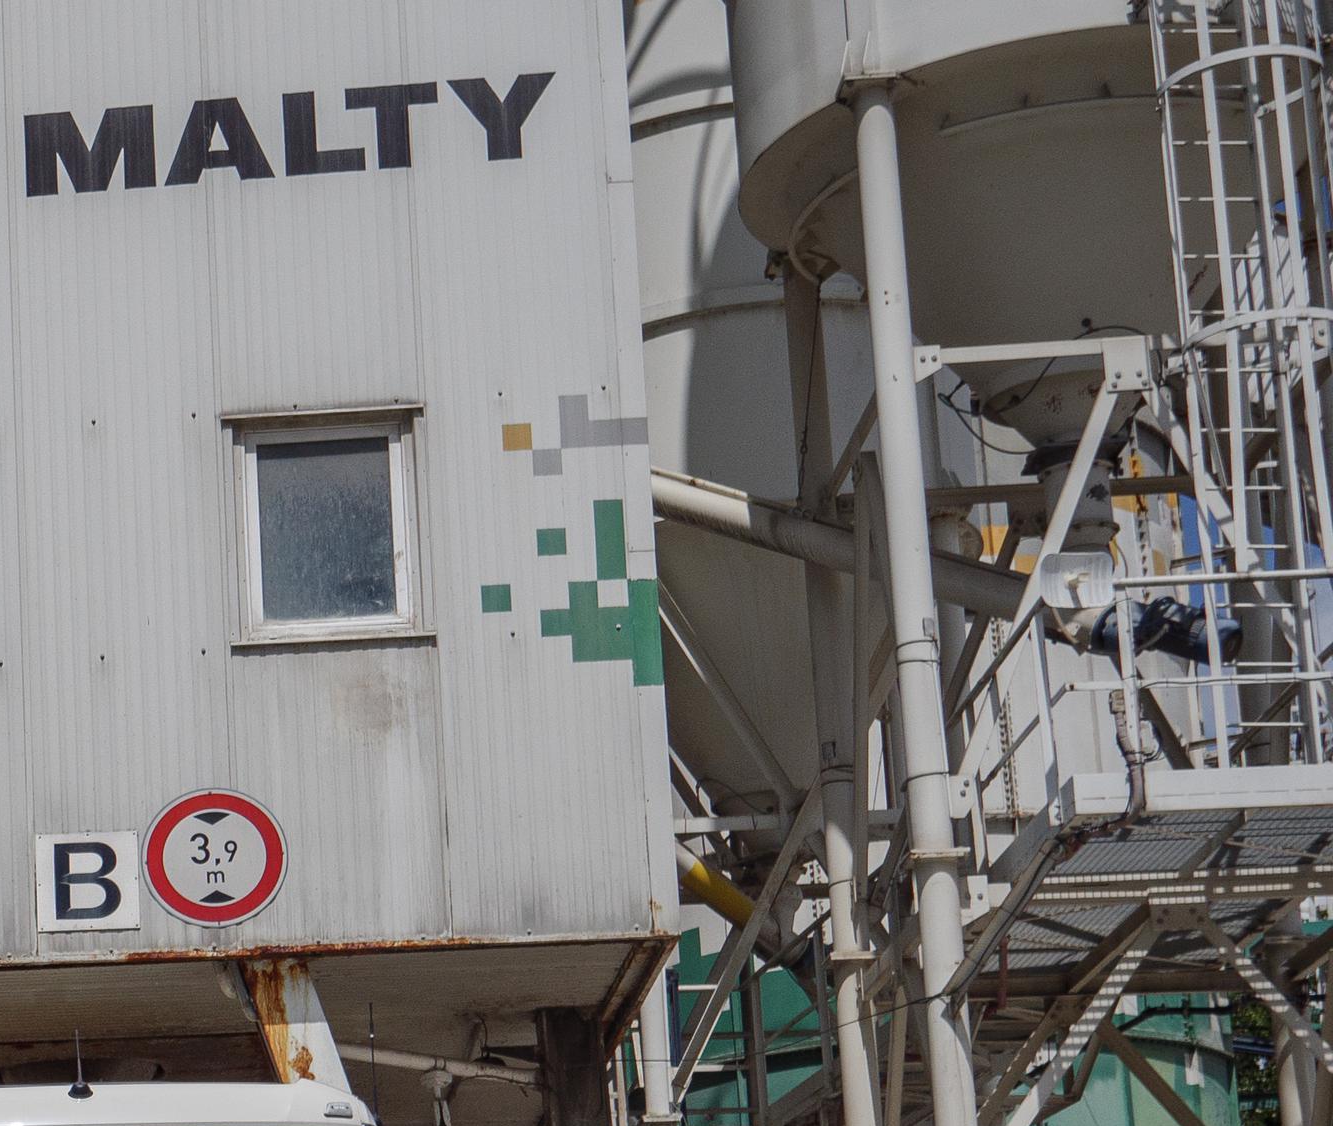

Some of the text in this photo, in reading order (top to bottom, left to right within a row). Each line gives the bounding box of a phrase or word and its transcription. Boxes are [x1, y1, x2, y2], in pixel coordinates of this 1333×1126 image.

[23, 71, 558, 198] MALTY
[189, 832, 239, 867] 3,9
[206, 870, 226, 884] m
[53, 841, 122, 920] B
